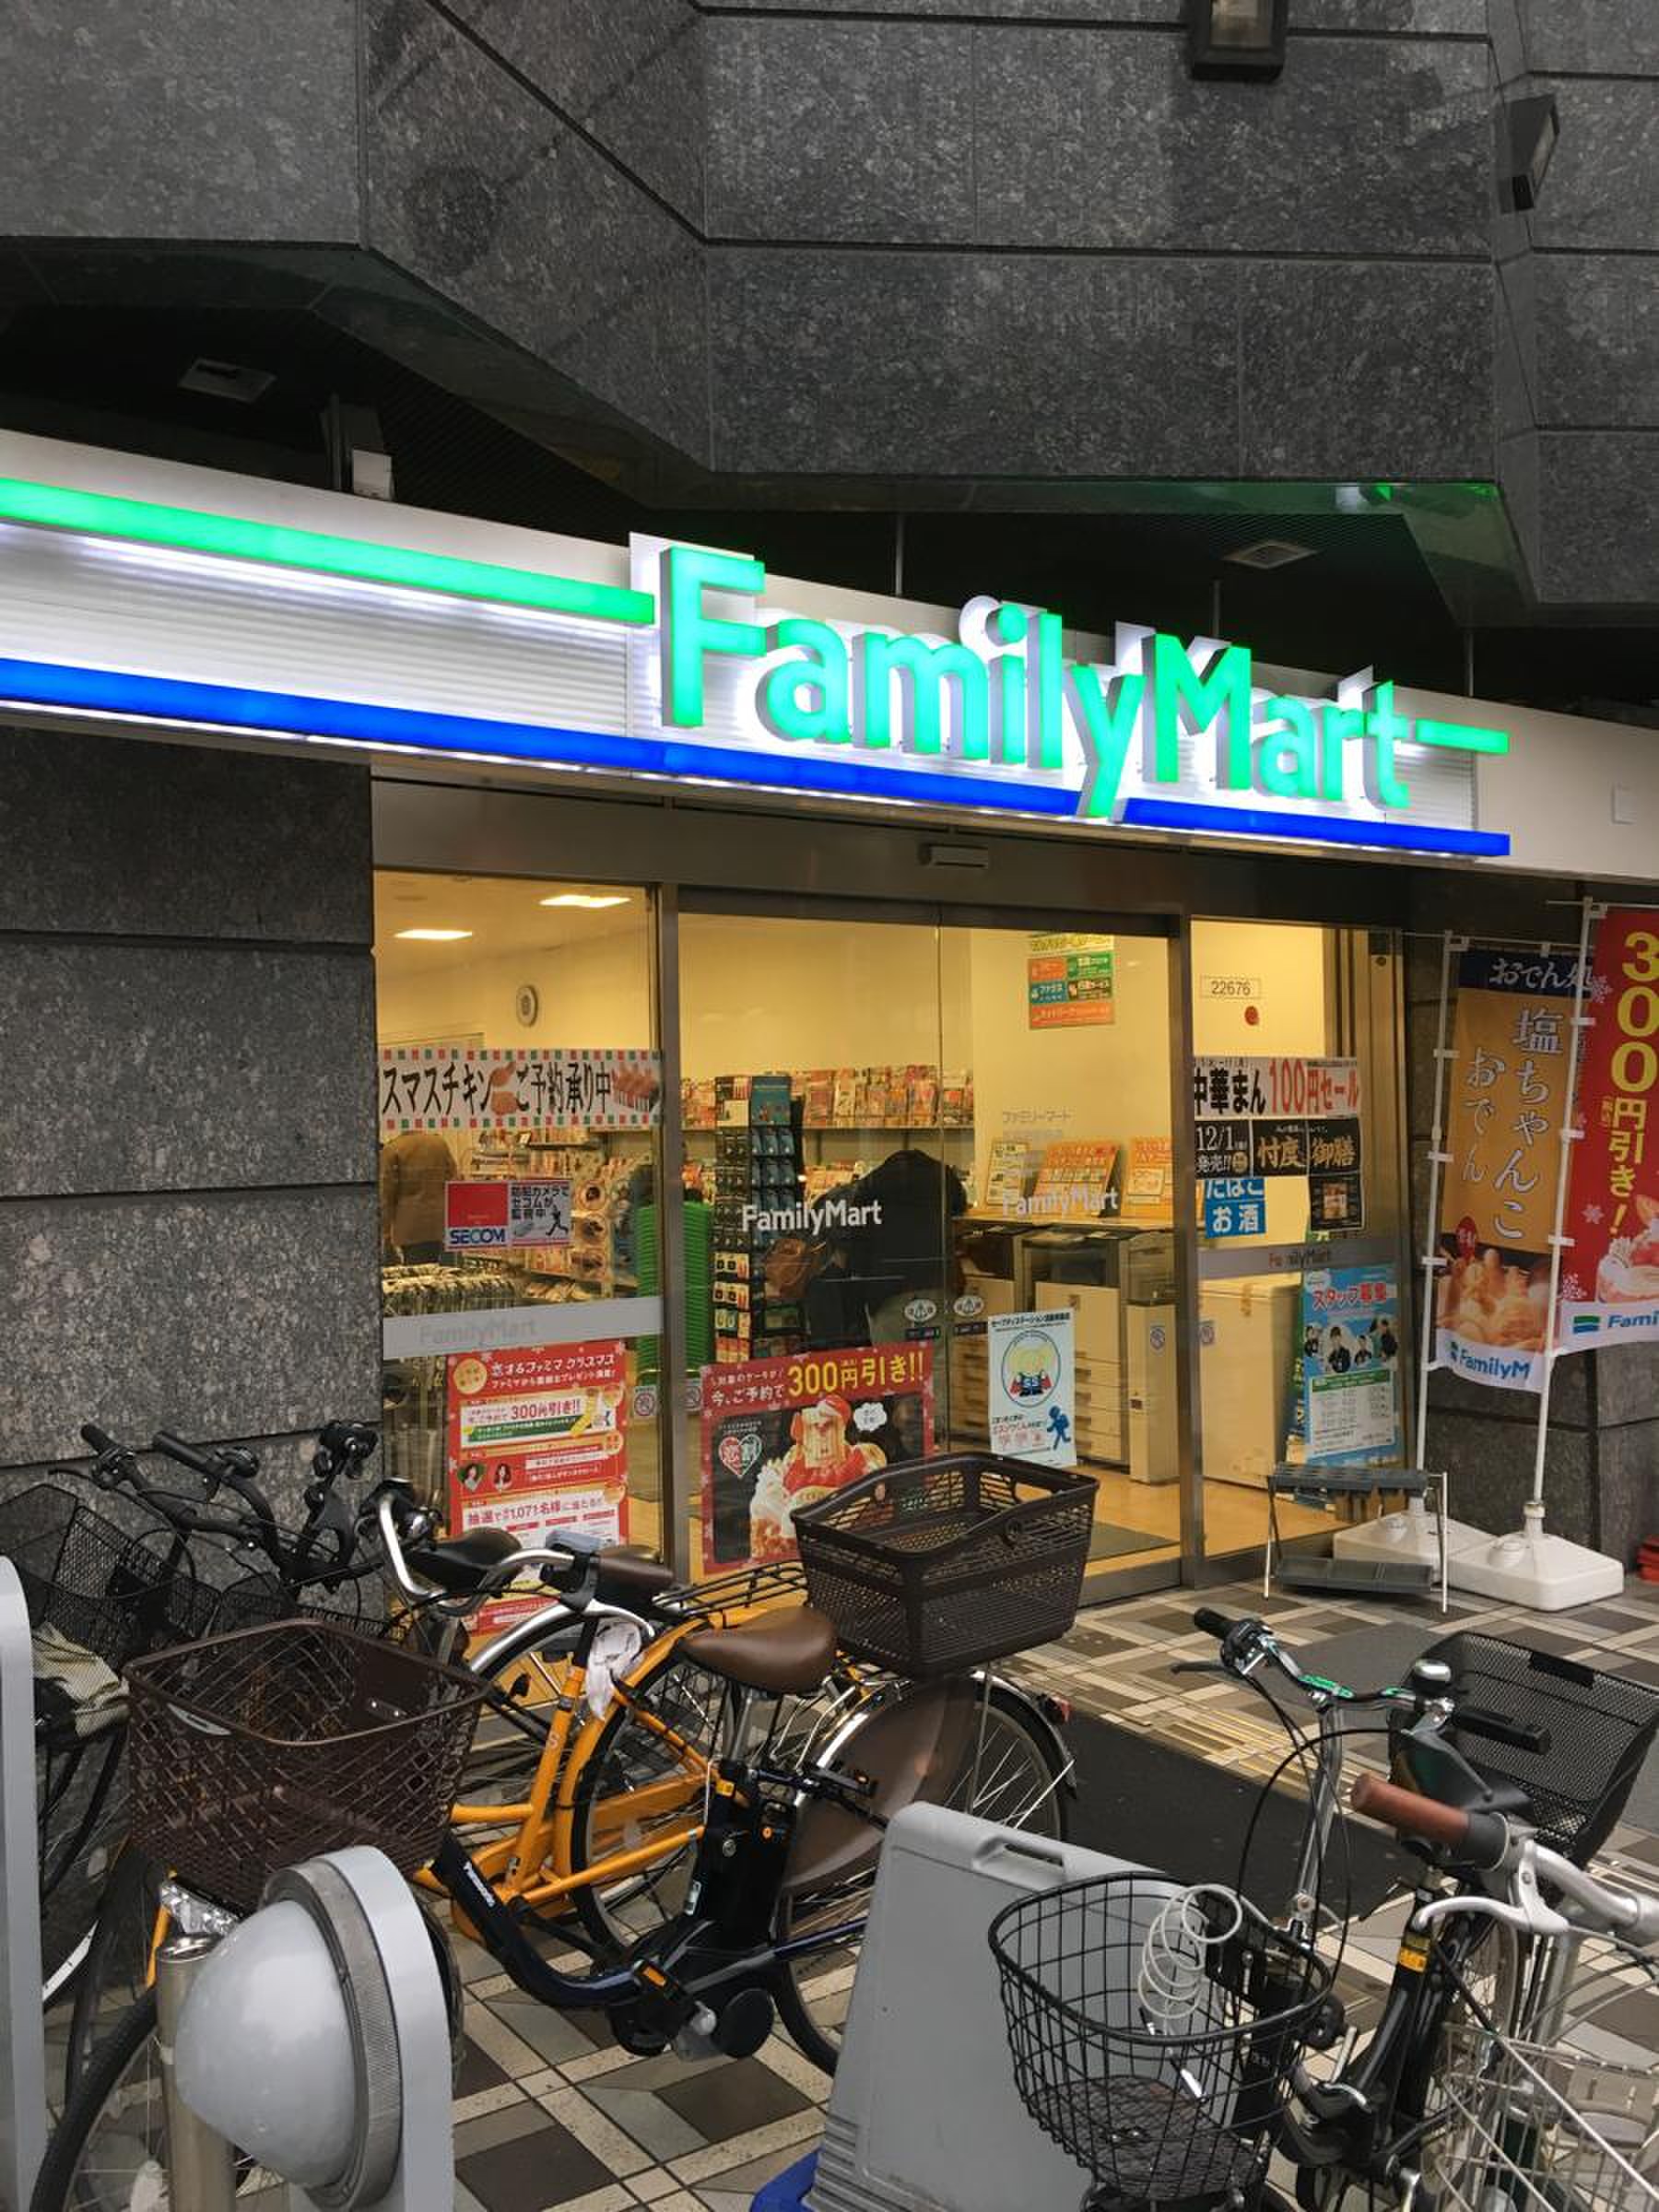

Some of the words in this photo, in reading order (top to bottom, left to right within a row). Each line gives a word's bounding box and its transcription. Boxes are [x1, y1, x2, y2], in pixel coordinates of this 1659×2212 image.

[660, 546, 1410, 818] FamilyMart
[1210, 980, 1252, 997] 22676
[382, 1061, 493, 1115] スマスチキン
[515, 1061, 612, 1115] ご予約承り中
[1462, 1046, 1506, 1182] おでん
[1494, 1006, 1564, 1240] 塩ちゃんこ
[1195, 1124, 1236, 1152] 12/1
[740, 1199, 883, 1235] FamilyMart
[1212, 1204, 1259, 1233] お酒
[449, 1227, 506, 1245] SECOM
[420, 1317, 536, 1347] FamilyMart
[787, 1350, 924, 1397] 300円引き!!
